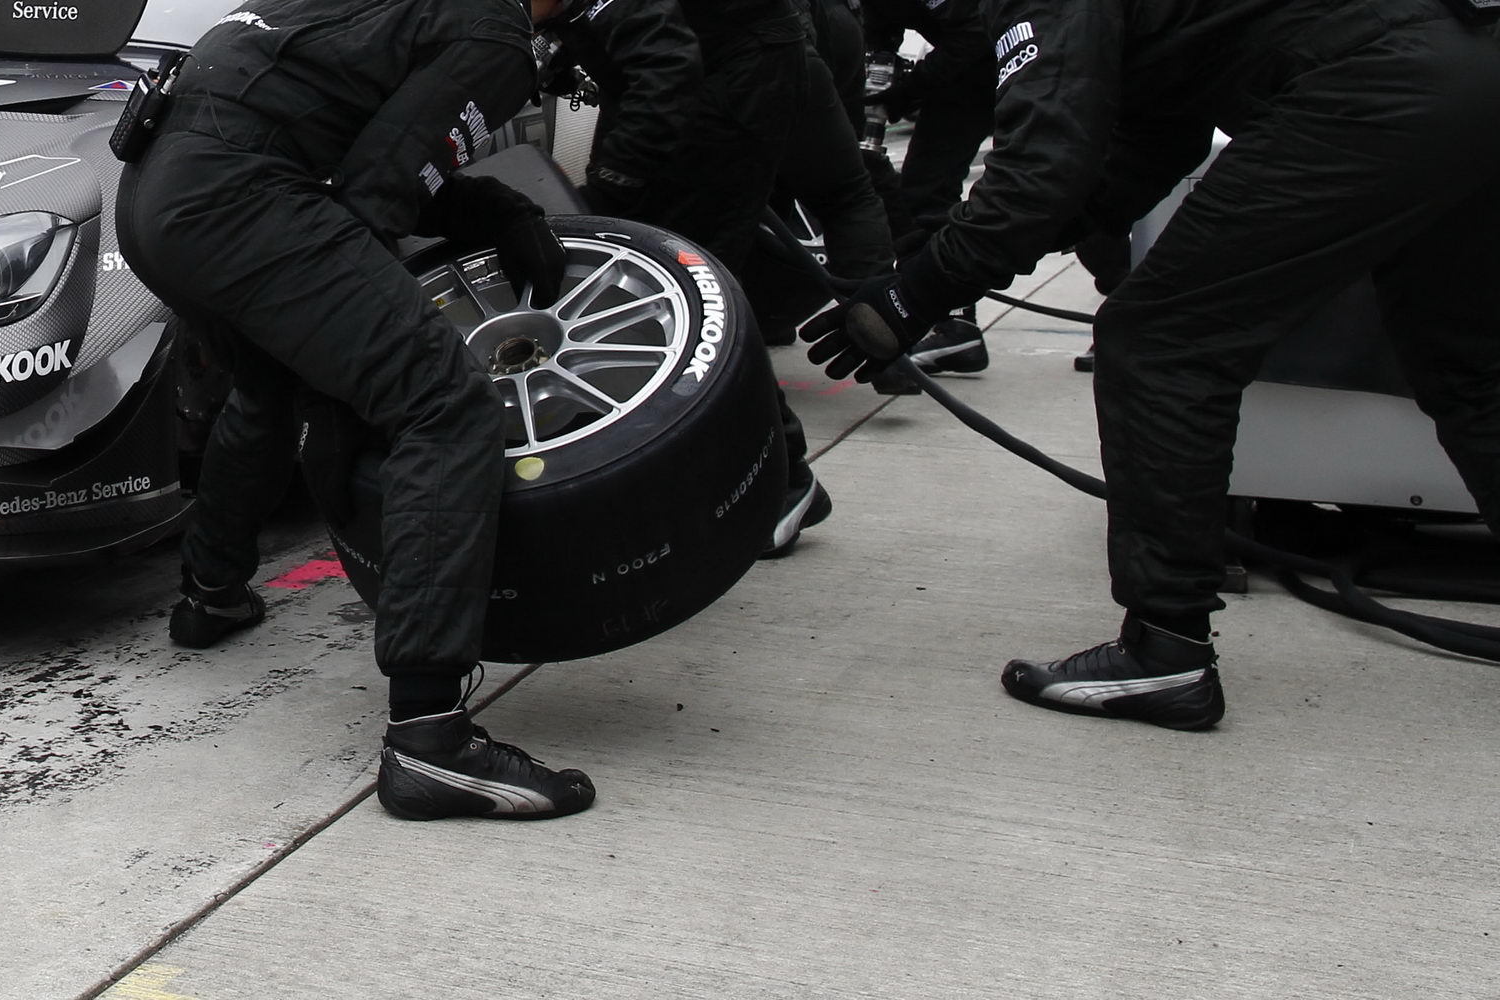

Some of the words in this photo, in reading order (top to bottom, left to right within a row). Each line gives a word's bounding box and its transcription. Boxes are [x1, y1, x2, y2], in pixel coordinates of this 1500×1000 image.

[12, 0, 79, 21] Service
[998, 44, 1039, 85] parco
[91, 475, 151, 501] Service
